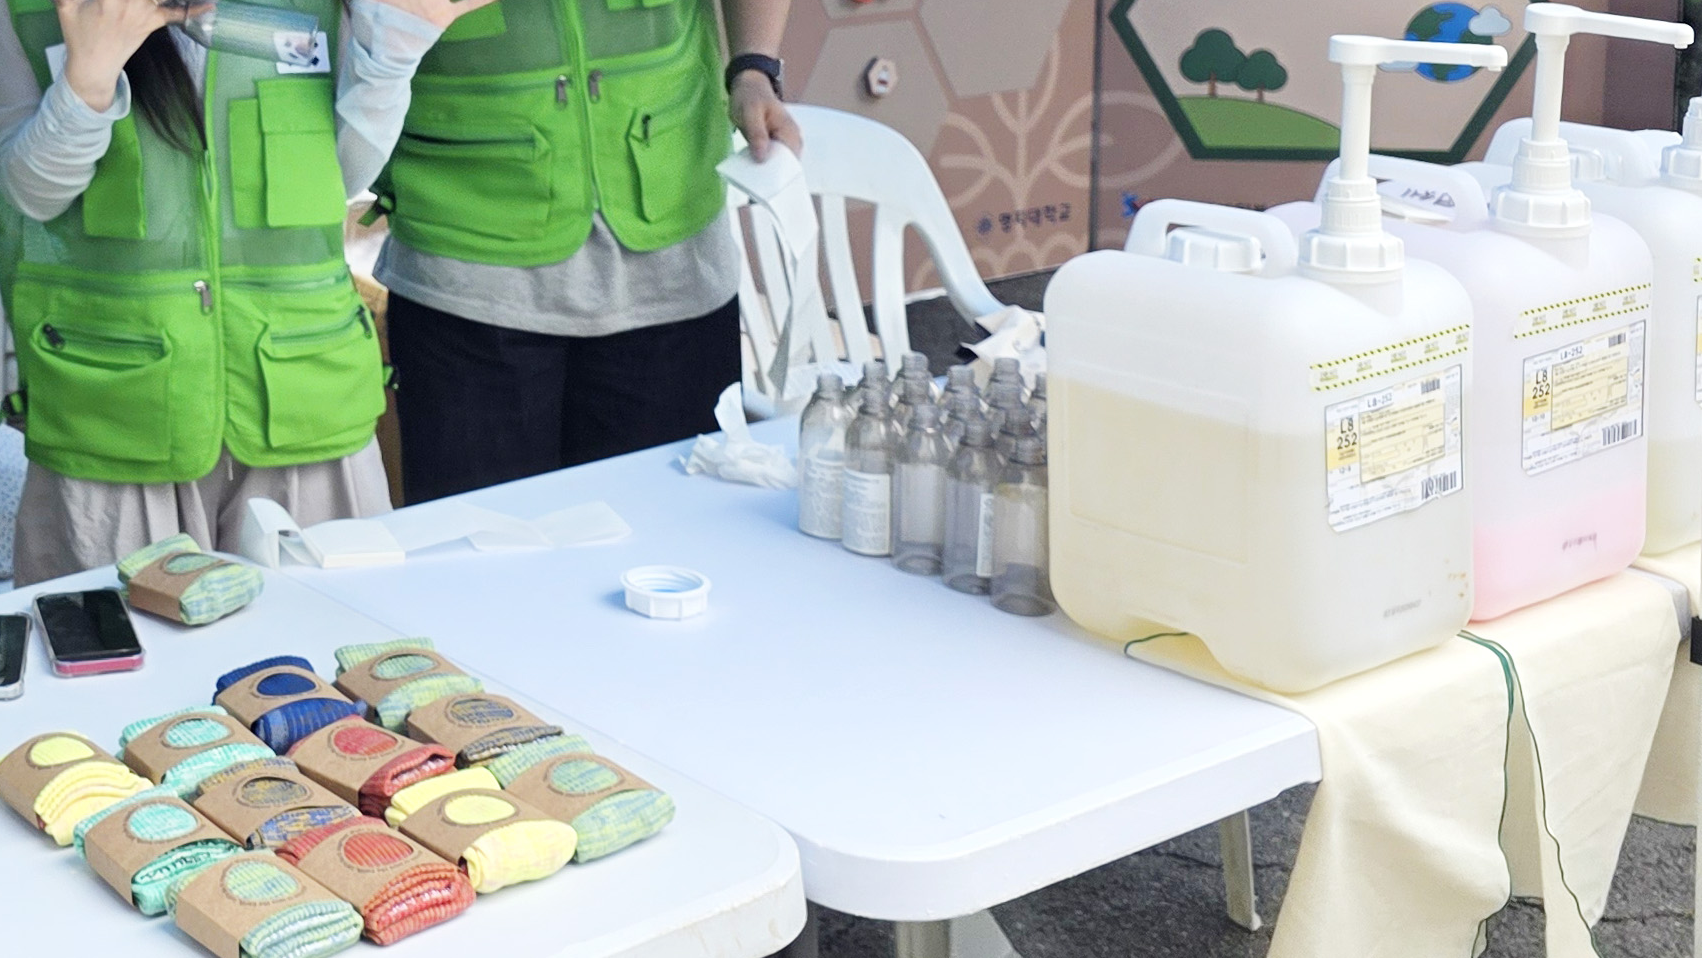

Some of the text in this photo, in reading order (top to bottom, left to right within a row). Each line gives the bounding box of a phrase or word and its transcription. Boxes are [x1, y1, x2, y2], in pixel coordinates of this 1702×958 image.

[1535, 369, 1548, 385] L8
[1532, 383, 1551, 400] 252
[1339, 417, 1355, 434] L8
[1336, 432, 1358, 450] 252
